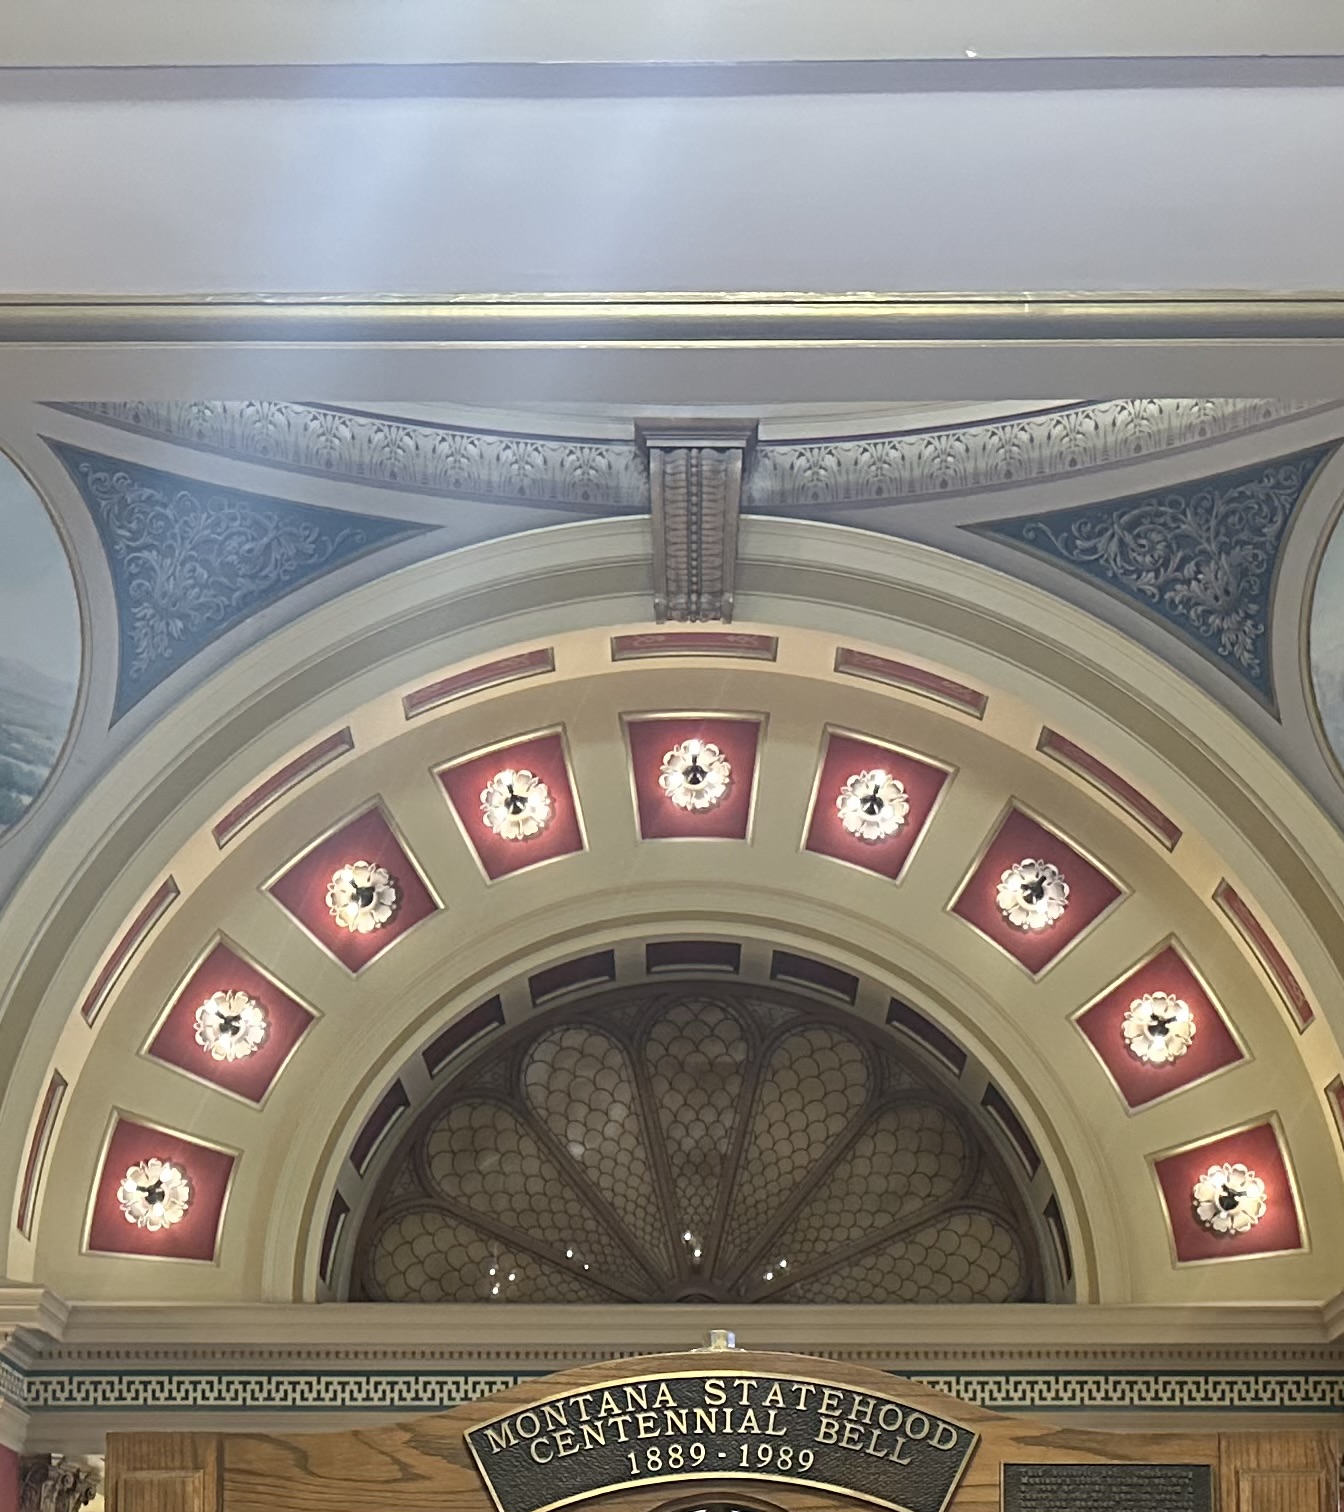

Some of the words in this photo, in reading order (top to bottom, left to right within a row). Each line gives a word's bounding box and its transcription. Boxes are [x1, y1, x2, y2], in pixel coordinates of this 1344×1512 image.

[483, 1382, 678, 1455] MONTANA
[703, 1378, 958, 1451] STATEHOOD
[529, 1407, 788, 1464] CENTENNIAL
[814, 1416, 913, 1466] BELL
